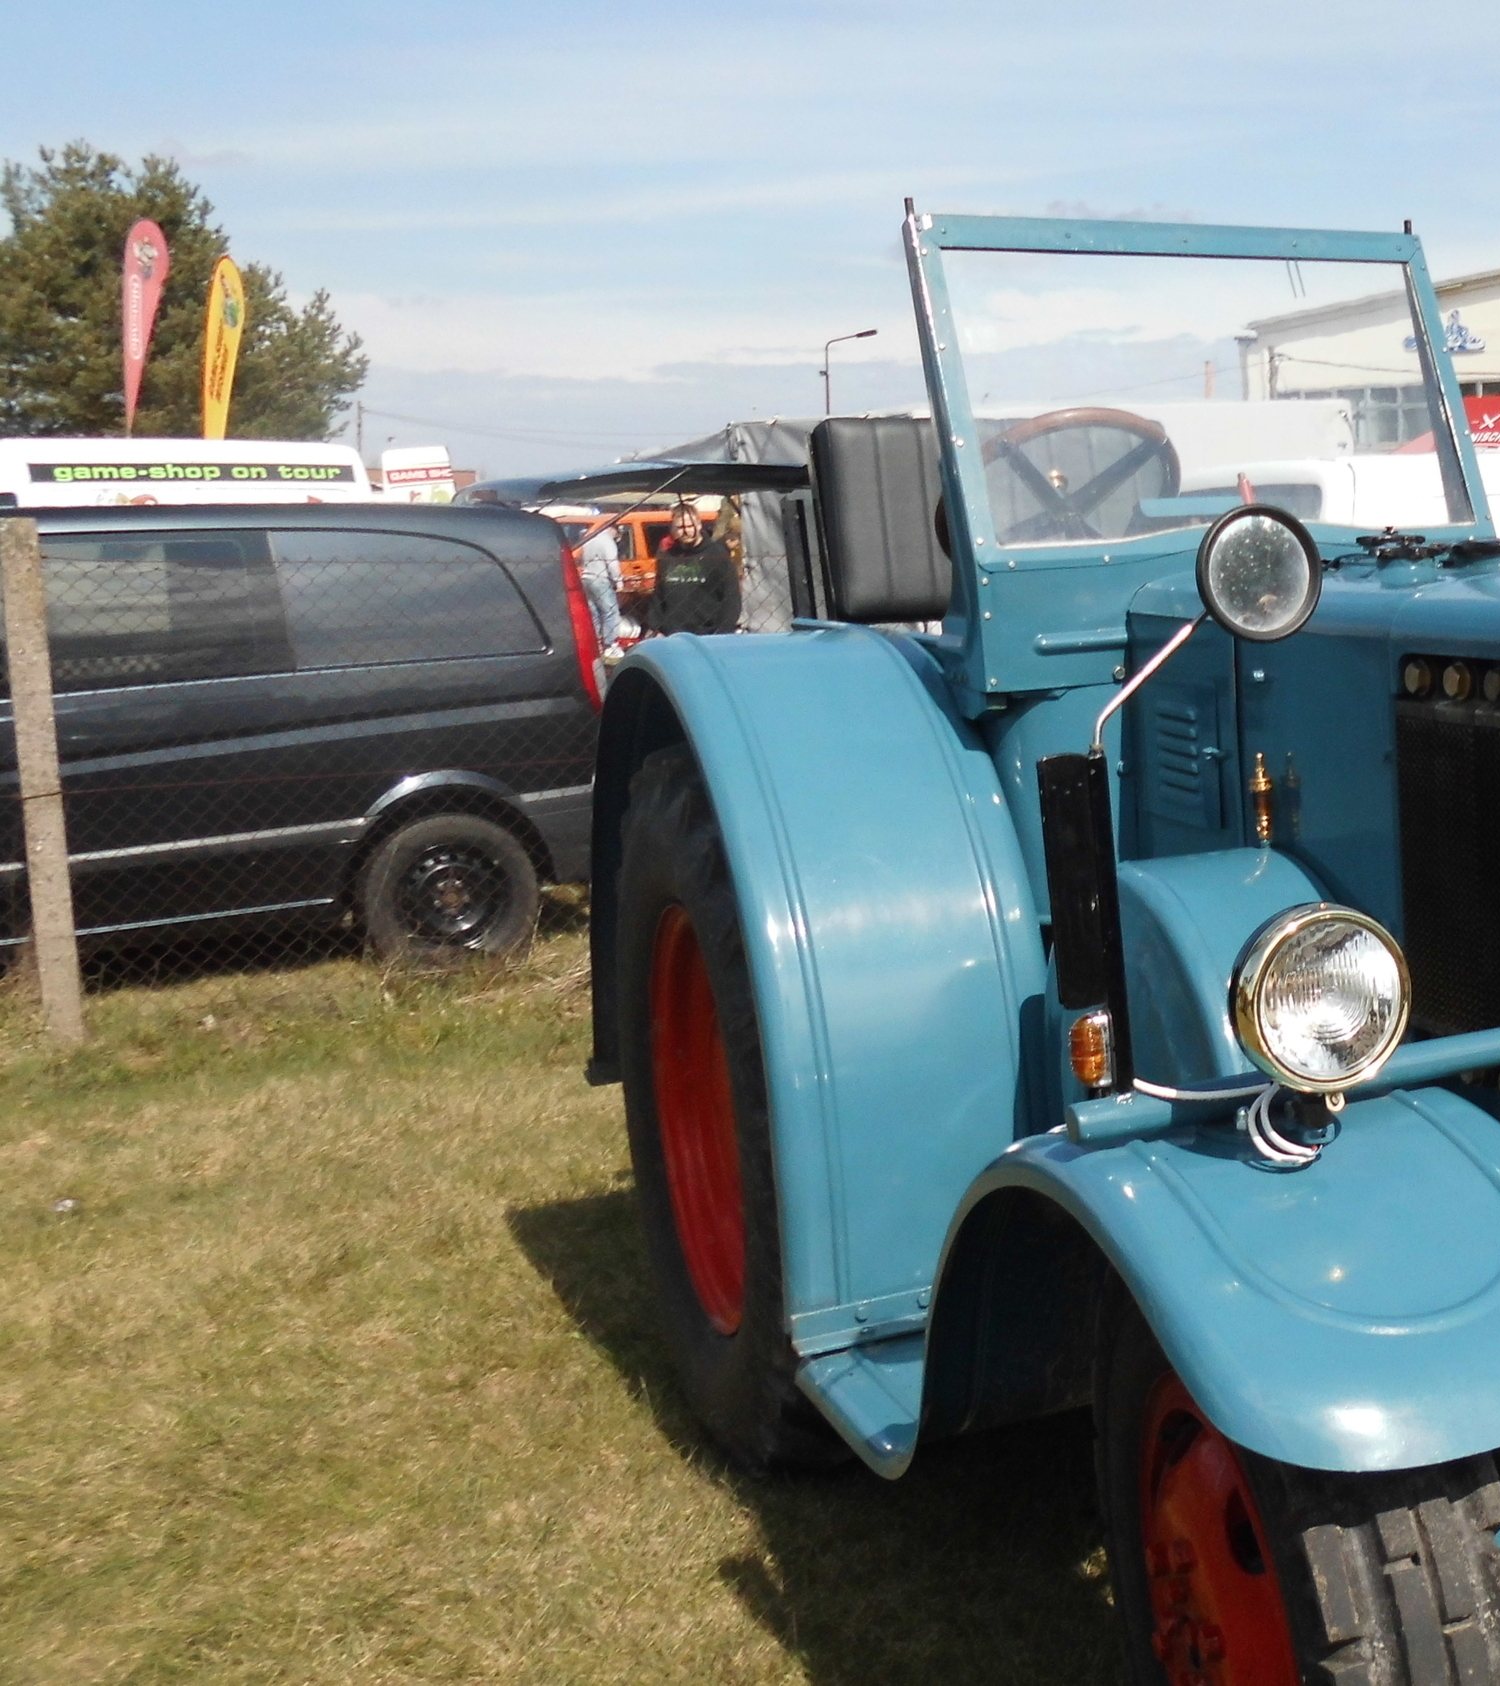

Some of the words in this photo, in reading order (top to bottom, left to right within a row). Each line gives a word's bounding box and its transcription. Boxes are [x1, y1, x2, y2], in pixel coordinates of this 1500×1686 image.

[53, 463, 221, 482] game-shop
[231, 466, 267, 479] on
[278, 465, 341, 479] tour
